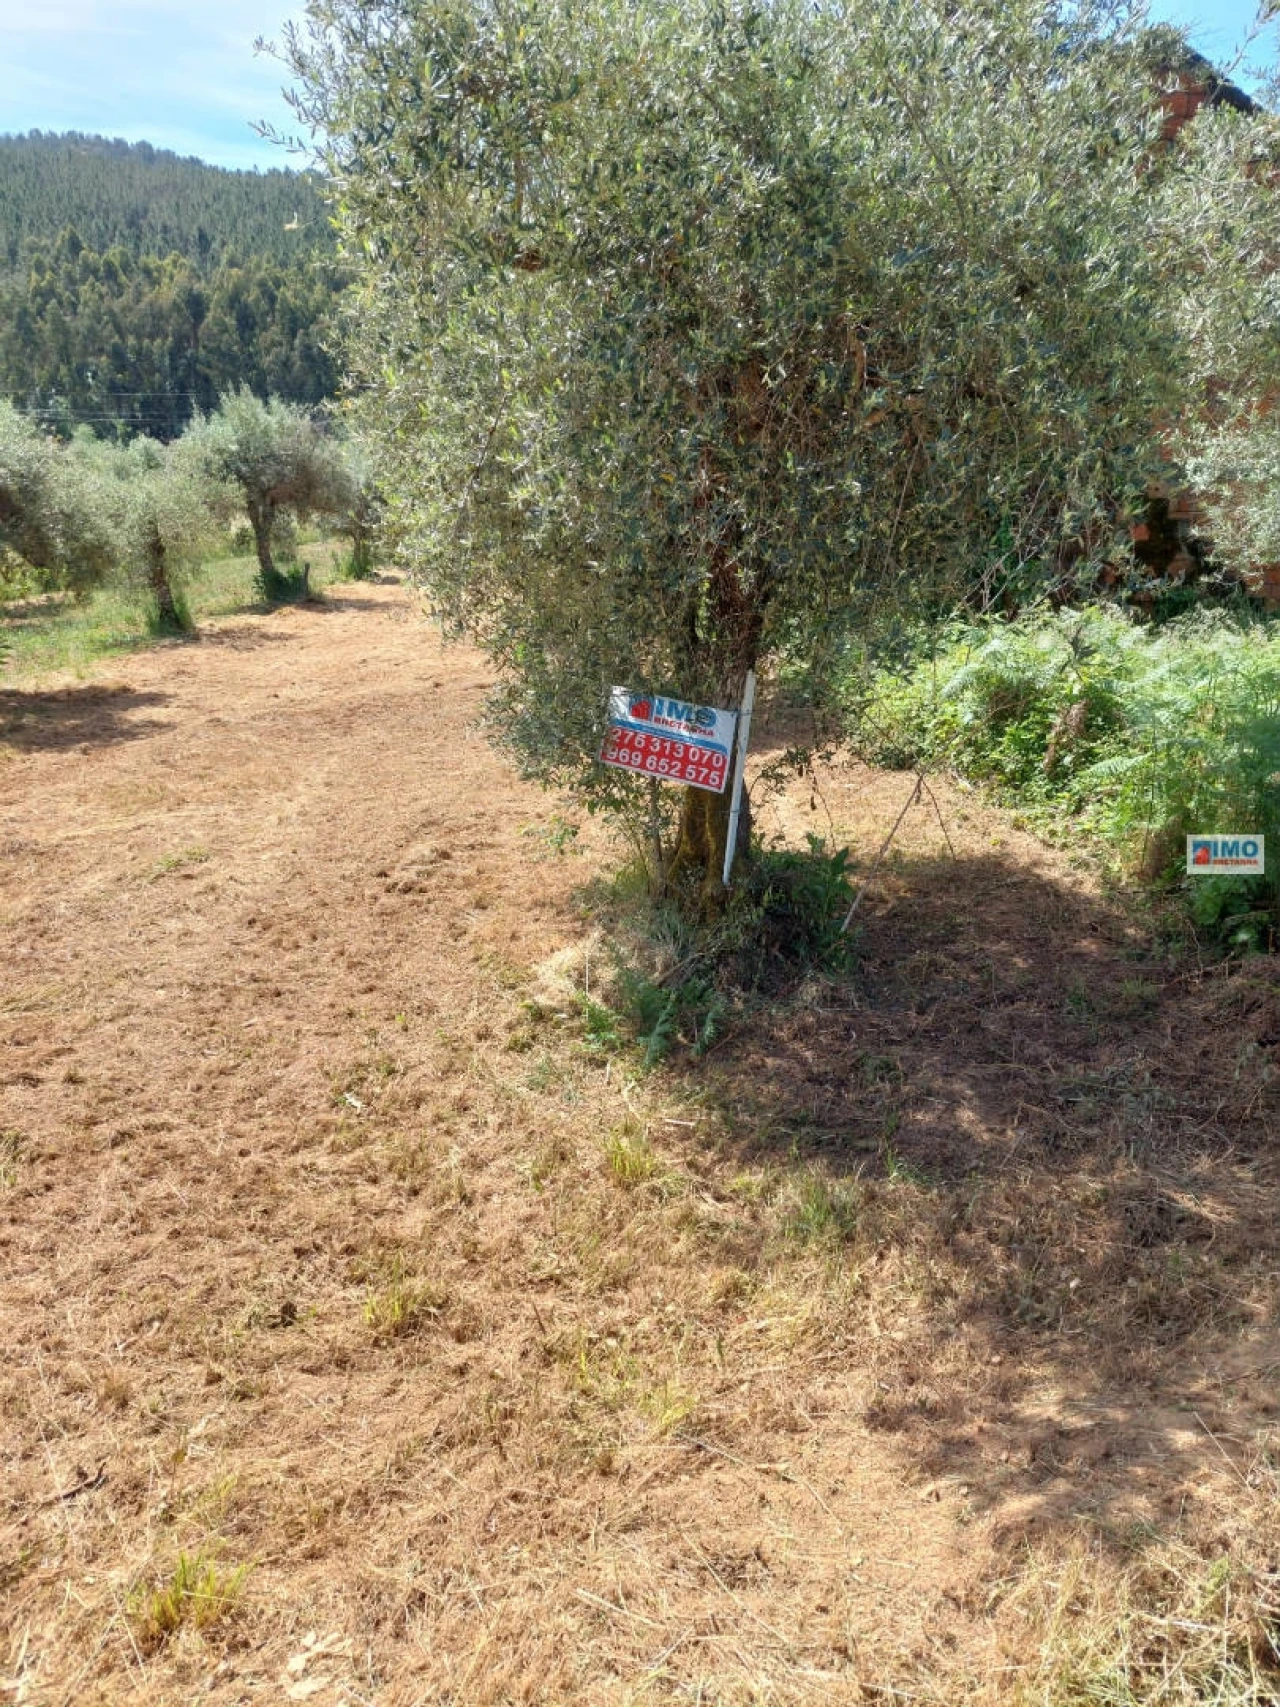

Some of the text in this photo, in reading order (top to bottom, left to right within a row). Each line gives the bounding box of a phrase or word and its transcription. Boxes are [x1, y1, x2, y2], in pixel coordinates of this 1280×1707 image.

[655, 698, 717, 728] IMO
[649, 740, 684, 758] 313
[688, 747, 723, 768] 070
[645, 754, 682, 776] 652
[685, 764, 720, 786] 575
